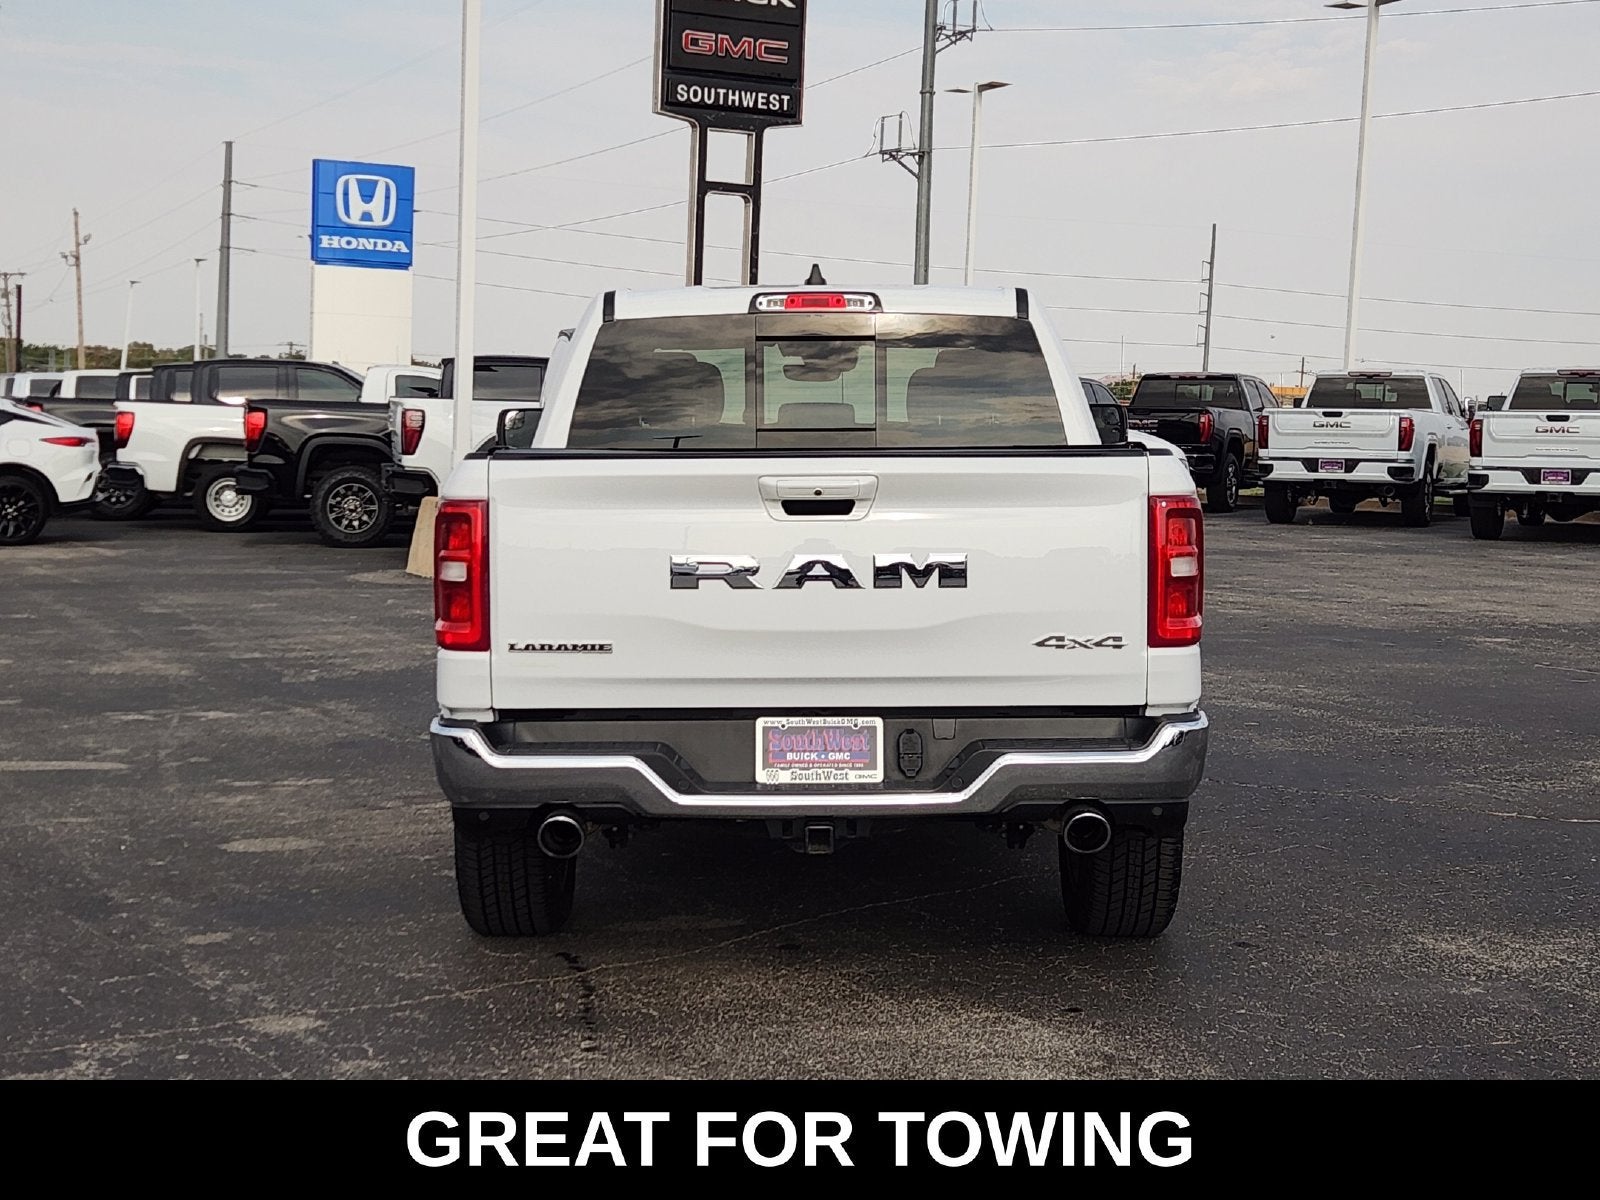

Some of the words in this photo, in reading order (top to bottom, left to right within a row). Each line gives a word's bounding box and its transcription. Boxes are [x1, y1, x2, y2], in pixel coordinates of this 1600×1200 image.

[682, 29, 789, 64] GMC
[676, 83, 791, 112] SOUTHWEST
[318, 234, 410, 253] HONDA
[1313, 420, 1351, 428] GMC
[1535, 425, 1580, 434] GMC
[670, 553, 968, 590] RAM
[508, 643, 613, 653] LARAMIE
[768, 728, 870, 751] SouthWest
[786, 752, 818, 760] BUICK
[828, 752, 851, 760] GMC
[790, 770, 849, 780] SouthWest
